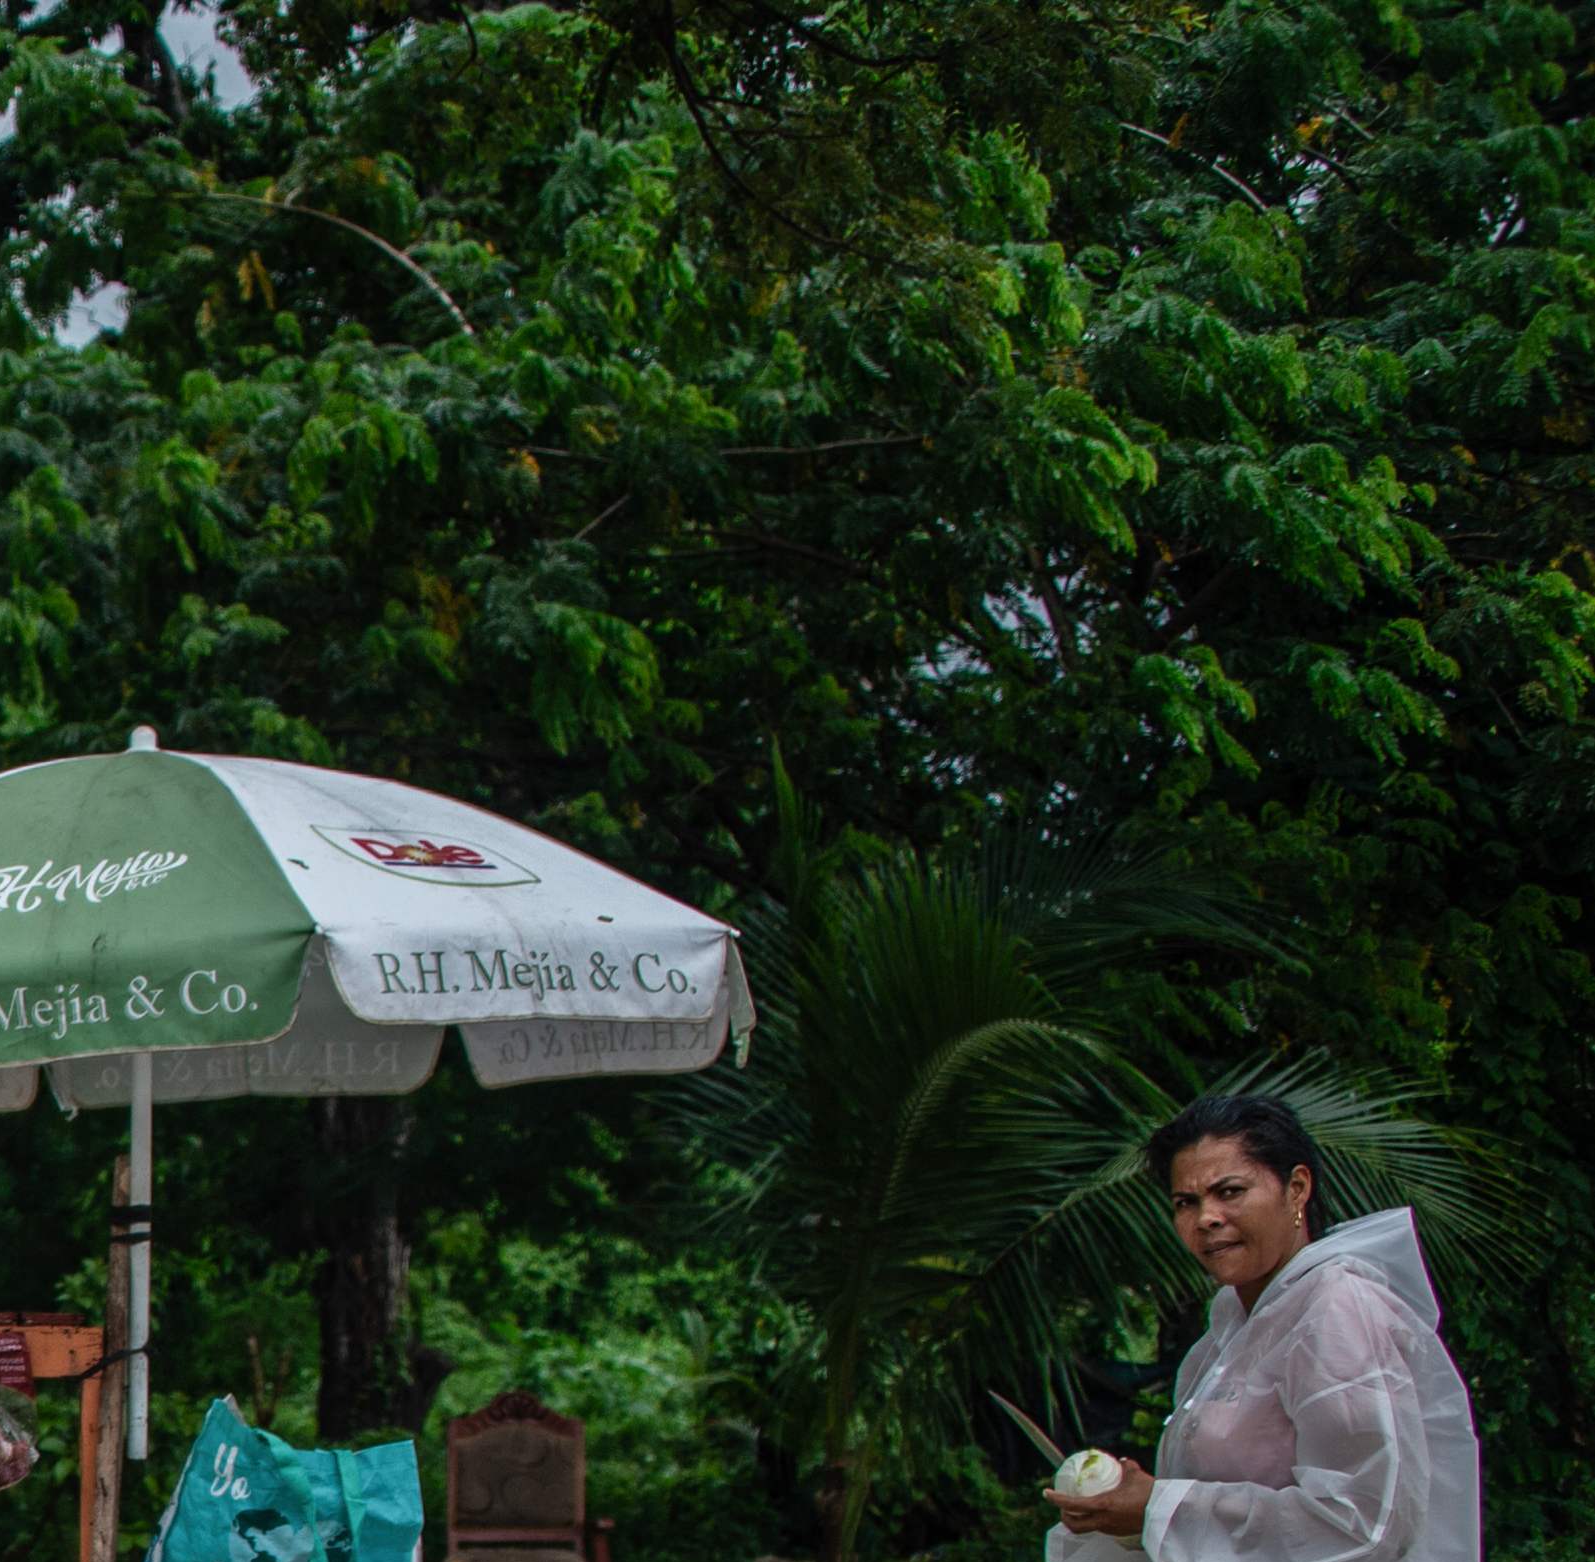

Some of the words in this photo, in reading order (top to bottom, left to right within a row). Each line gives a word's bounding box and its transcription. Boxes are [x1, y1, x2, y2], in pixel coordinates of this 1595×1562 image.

[124, 975, 165, 1021] &
[180, 970, 259, 1016] Co.
[373, 951, 460, 995] R.H.
[464, 950, 577, 1001] Mejía
[589, 951, 620, 993] &
[632, 953, 698, 995] Co.
[210, 1442, 251, 1500] Yo
